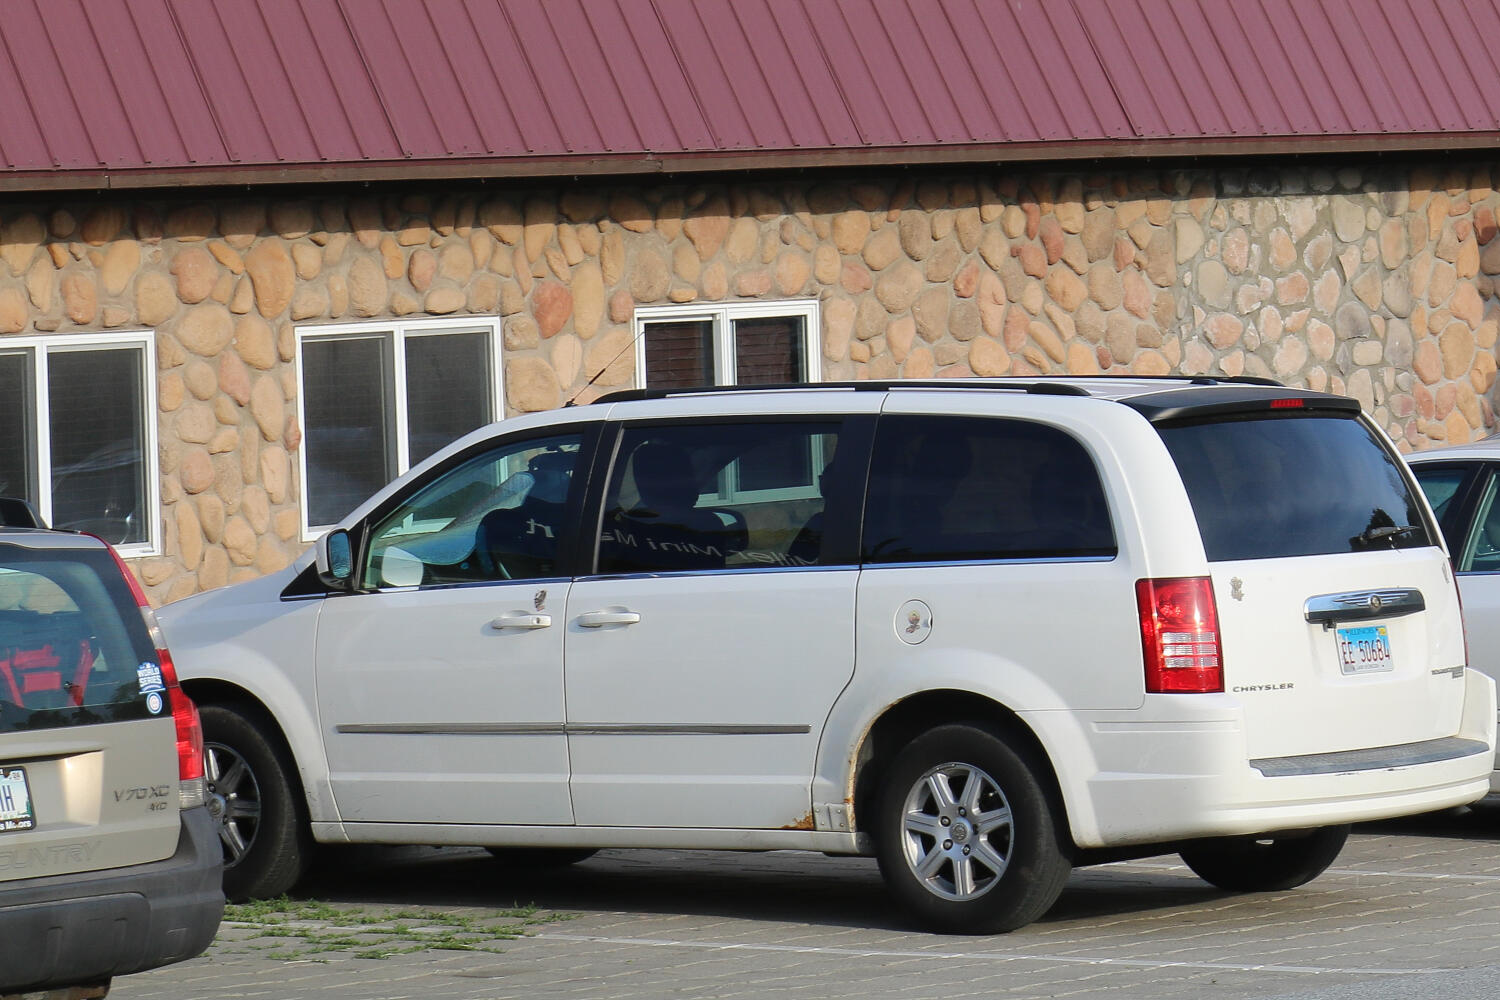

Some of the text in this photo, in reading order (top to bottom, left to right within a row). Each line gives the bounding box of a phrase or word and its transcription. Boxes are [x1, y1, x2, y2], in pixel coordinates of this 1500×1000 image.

[1341, 639, 1390, 664] EE 50684
[1232, 682, 1294, 692] CHRYSLER
